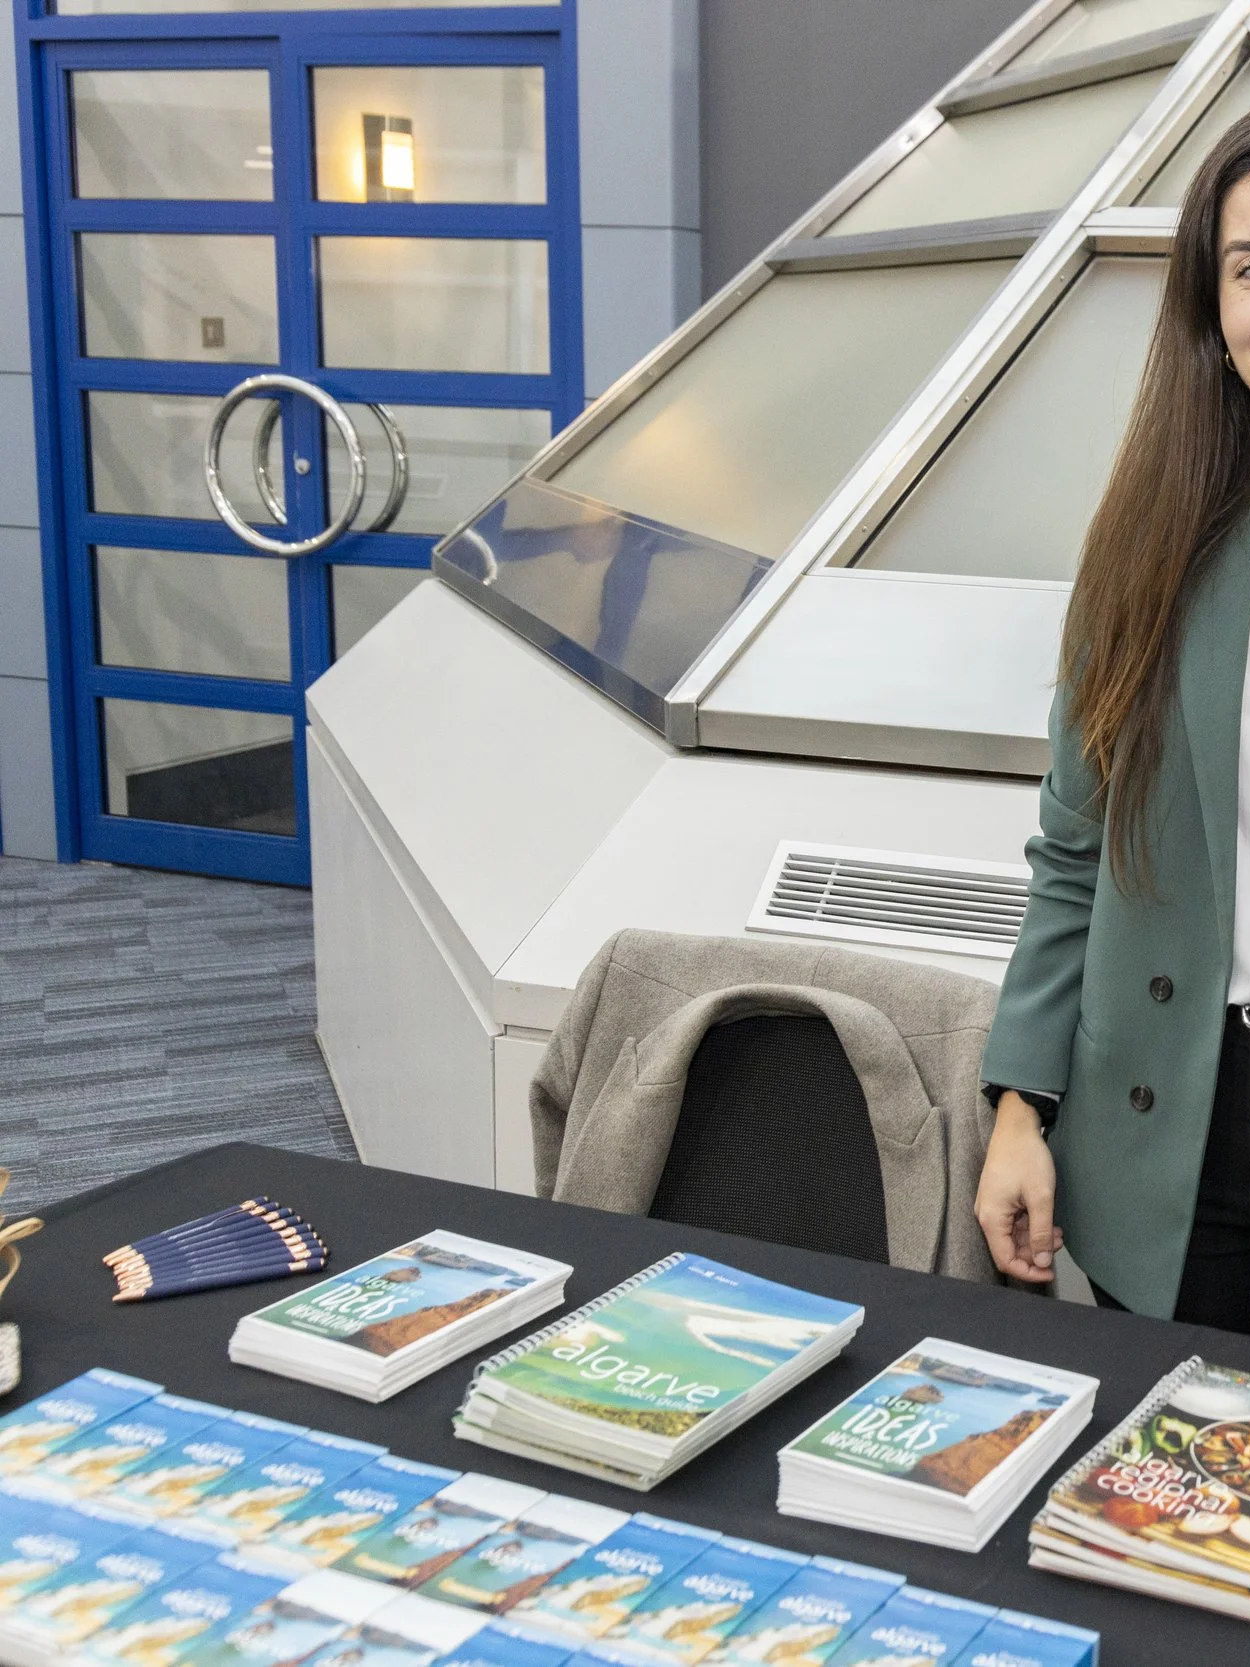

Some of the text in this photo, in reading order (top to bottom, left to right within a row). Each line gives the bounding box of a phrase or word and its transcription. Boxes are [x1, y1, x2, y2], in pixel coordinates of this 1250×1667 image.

[311, 1282, 409, 1320] IDEAS
[551, 1342, 721, 1404] algarve
[614, 1382, 657, 1402] beach
[841, 1403, 949, 1450] IDEAS
[874, 1394, 961, 1422] algarve
[820, 1430, 917, 1466] INSPIRATIONS
[1109, 1460, 1234, 1514] regional
[1122, 1450, 1229, 1496] algarve
[1096, 1474, 1217, 1528] cooking
